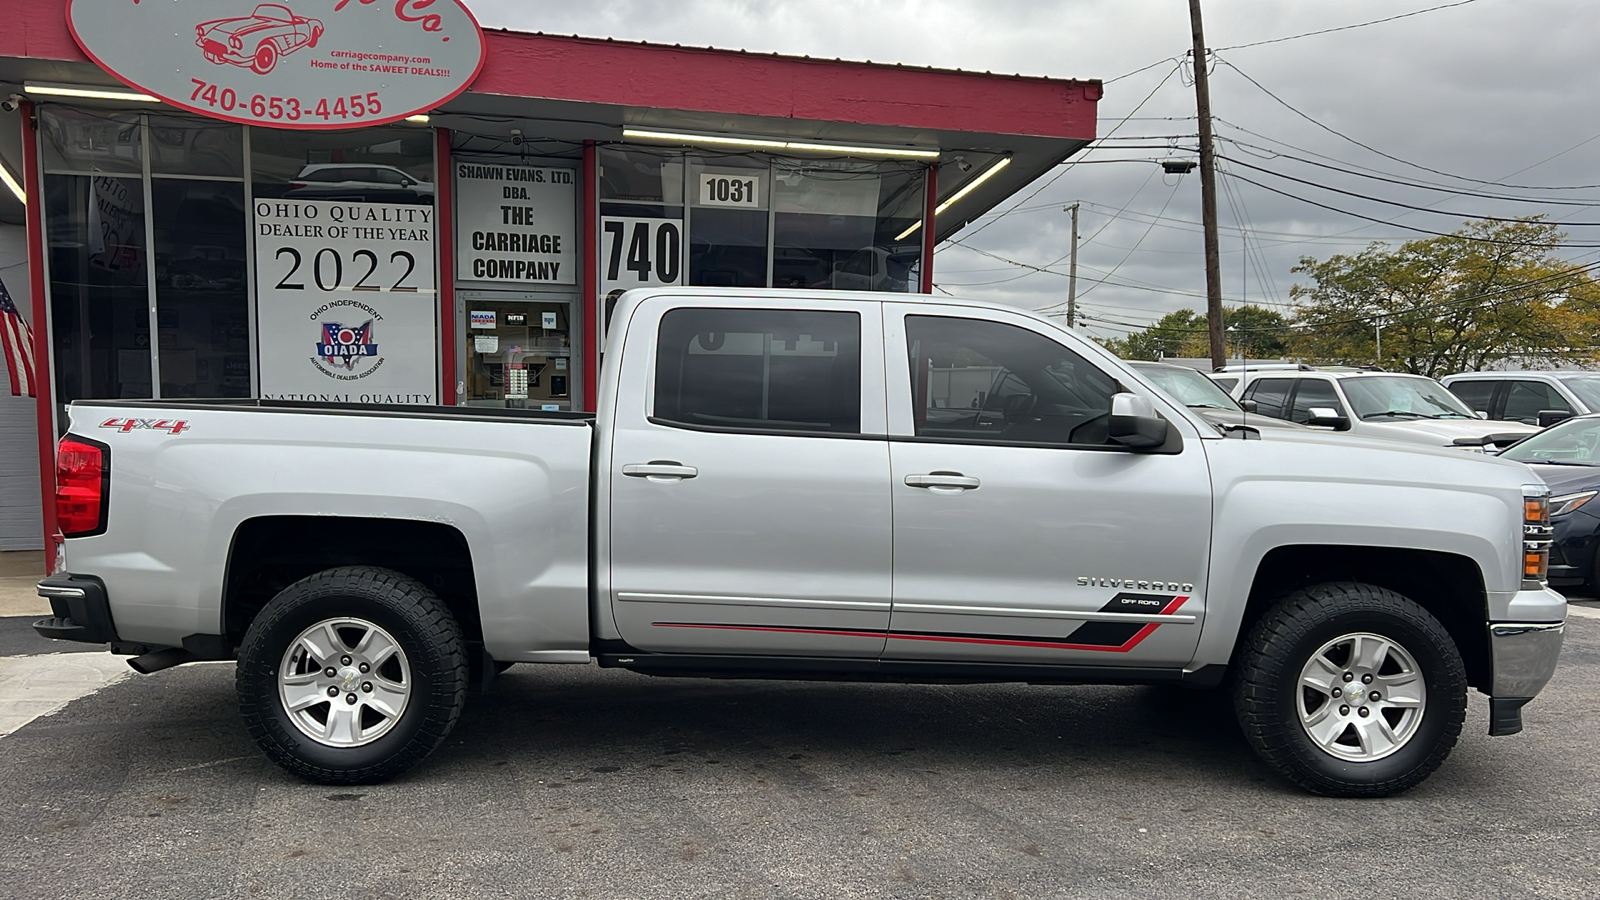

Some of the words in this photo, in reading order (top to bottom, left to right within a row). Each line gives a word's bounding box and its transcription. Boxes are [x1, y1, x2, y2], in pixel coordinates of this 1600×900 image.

[330, 51, 431, 64] carriagecompany.com
[310, 60, 338, 69] Home
[340, 62, 350, 70] of
[352, 63, 368, 72] the
[369, 64, 409, 75] SAWEET
[411, 67, 450, 78] DEALS!!!
[190, 78, 382, 121] 740-653-4455
[459, 165, 503, 181] SHAWN
[551, 171, 574, 185] LTD.
[503, 186, 531, 200] DBA.
[706, 178, 753, 203] 1031
[257, 203, 318, 219] OHIO
[330, 206, 431, 223] QUALITY
[501, 206, 534, 226] THE
[260, 223, 323, 238] DEALER
[328, 226, 349, 239] OF
[352, 227, 384, 240] THE
[388, 228, 429, 242] YEAR
[472, 231, 561, 254] CARRIAGE
[604, 221, 680, 284] 740
[275, 247, 418, 293] 2022
[473, 258, 561, 281] COMPANY
[310, 304, 328, 321] OHIO
[329, 300, 384, 322] INDEPENDENT
[324, 345, 368, 355] OIADA
[309, 357, 336, 378] AUTOMOBILE
[359, 357, 385, 378] ASSOCIATION
[360, 394, 431, 404] QUALITY
[1077, 577, 1194, 593] SILVERADO
